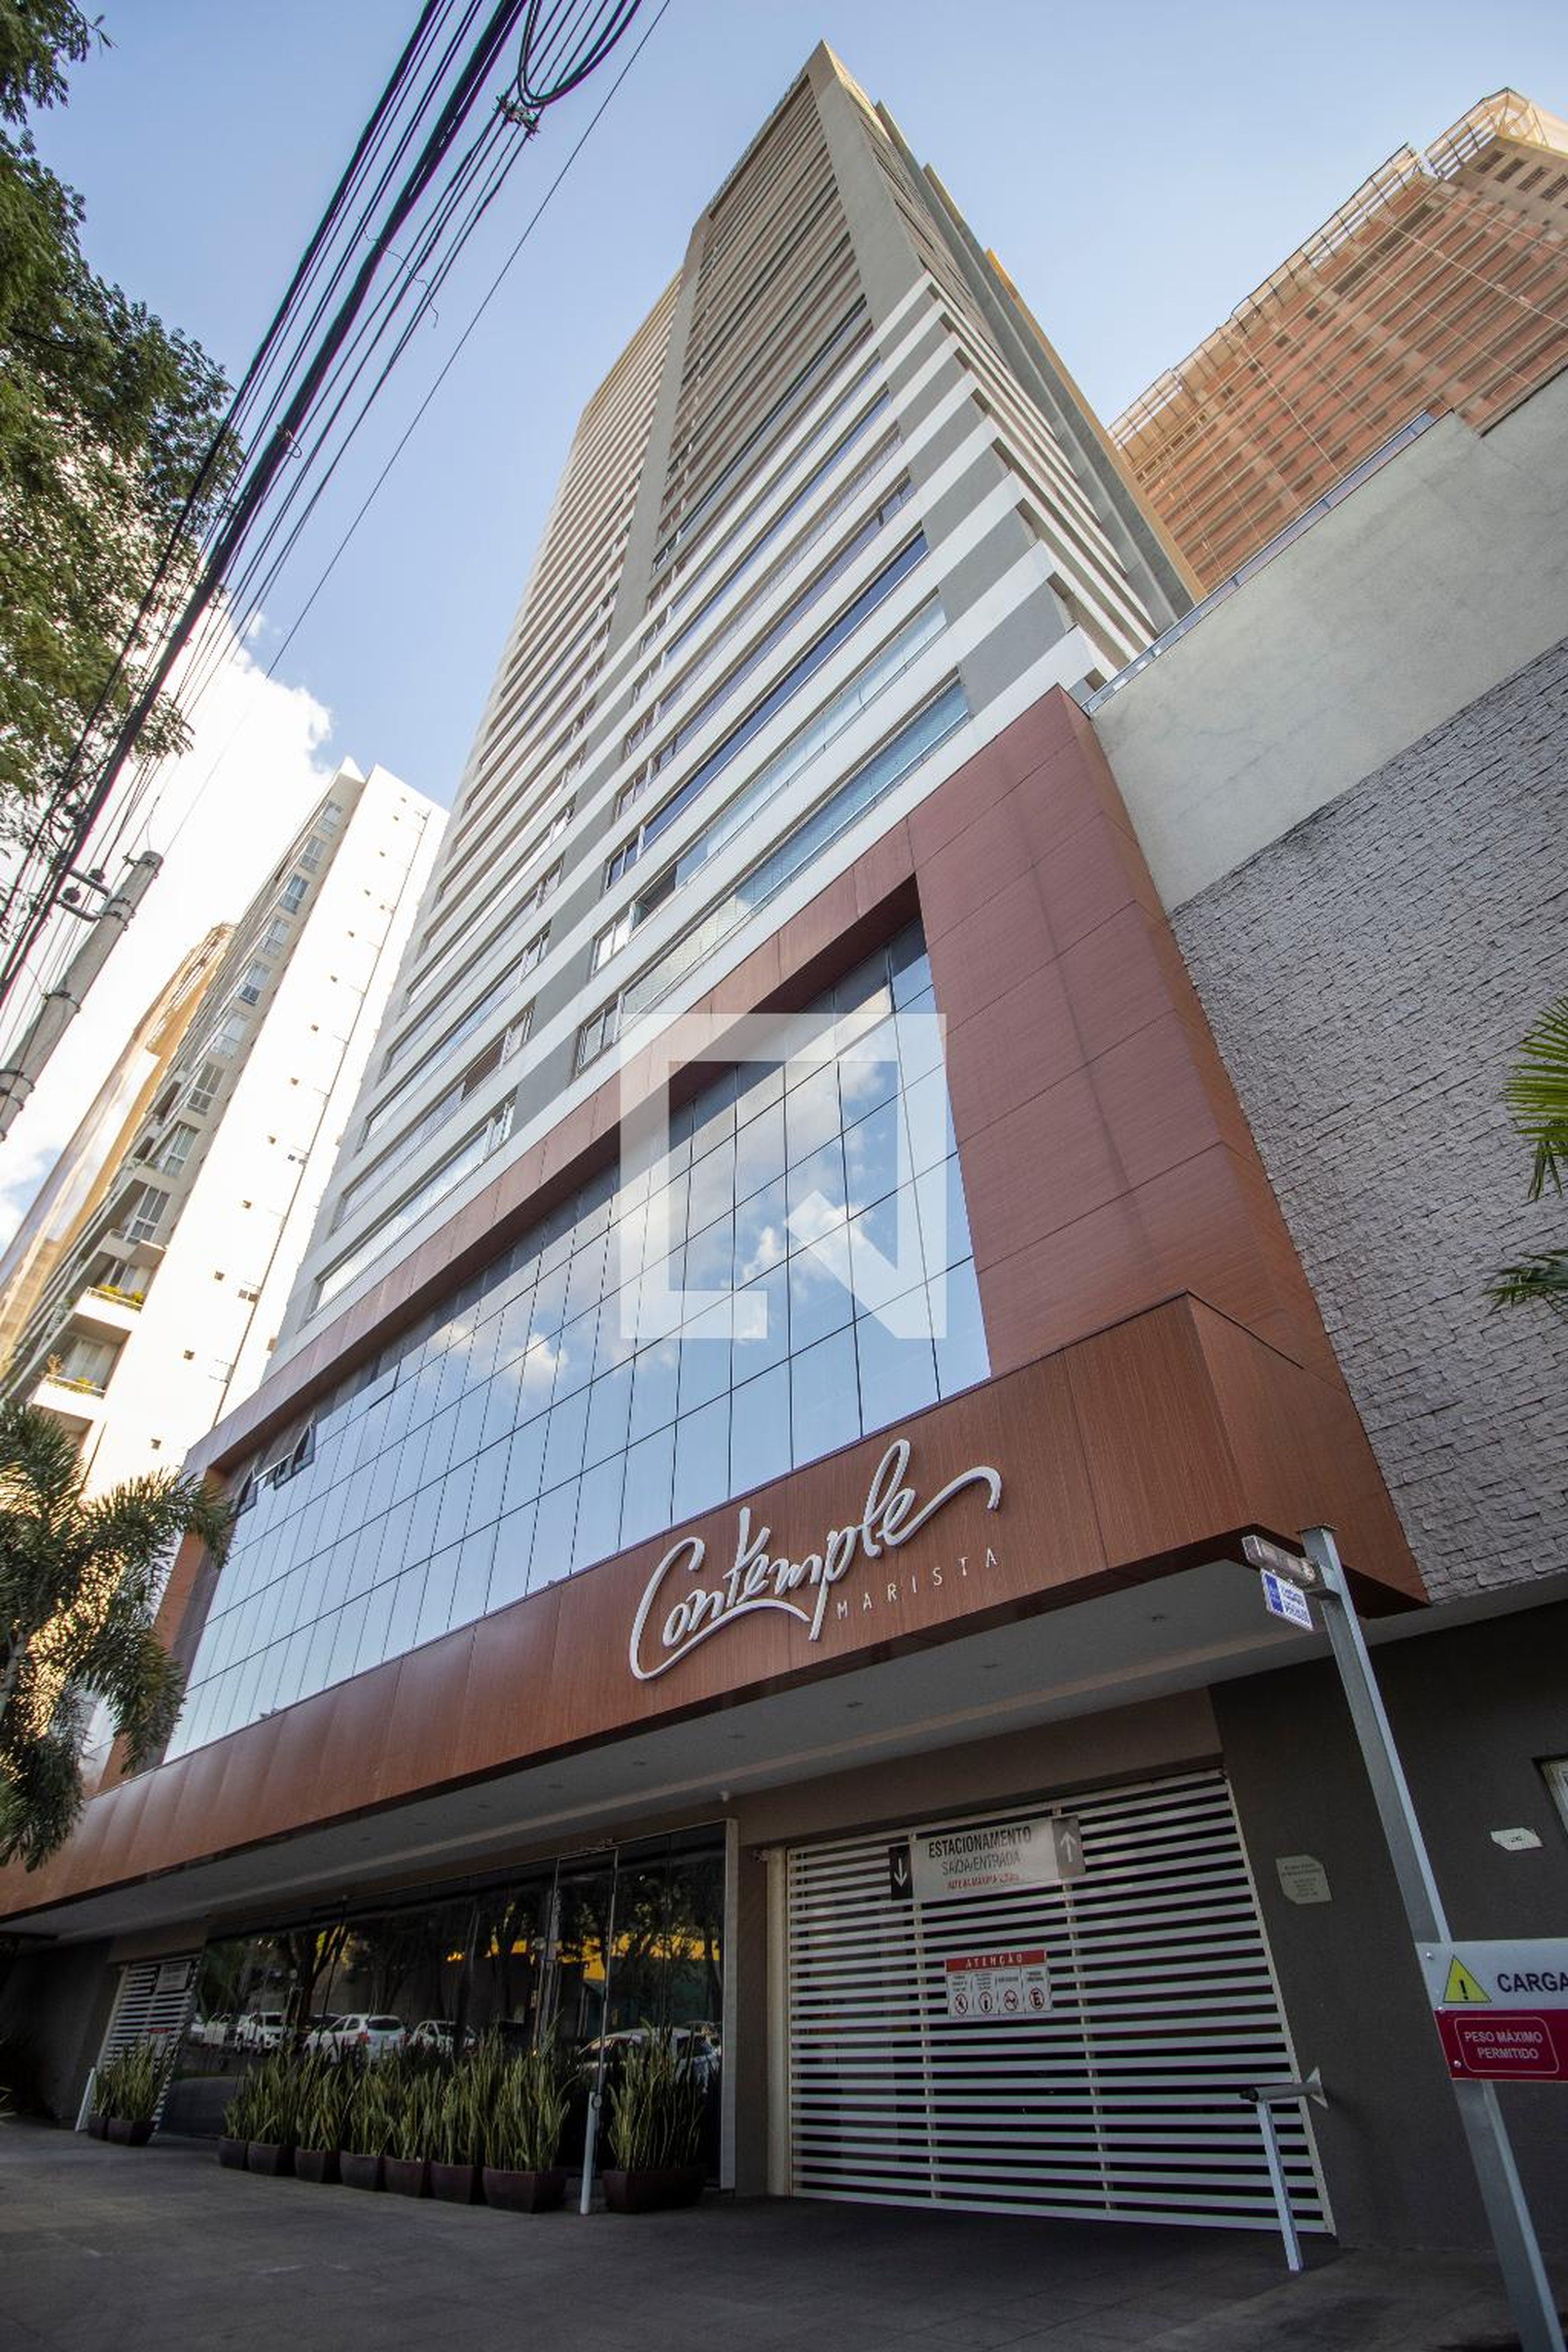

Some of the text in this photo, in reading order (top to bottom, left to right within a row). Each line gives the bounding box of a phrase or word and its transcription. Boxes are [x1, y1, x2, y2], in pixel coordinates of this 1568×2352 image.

[629, 1439, 1002, 1680] Contemple
[837, 1547, 998, 1619] MARISTA
[929, 1826, 1031, 1858] ESTACIONAMENTO
[965, 1952, 1022, 1969] ATENÇÃO
[1465, 2028, 1544, 2043] PESO MÁXIMO
[1477, 2047, 1539, 2060] PERMITIDO
